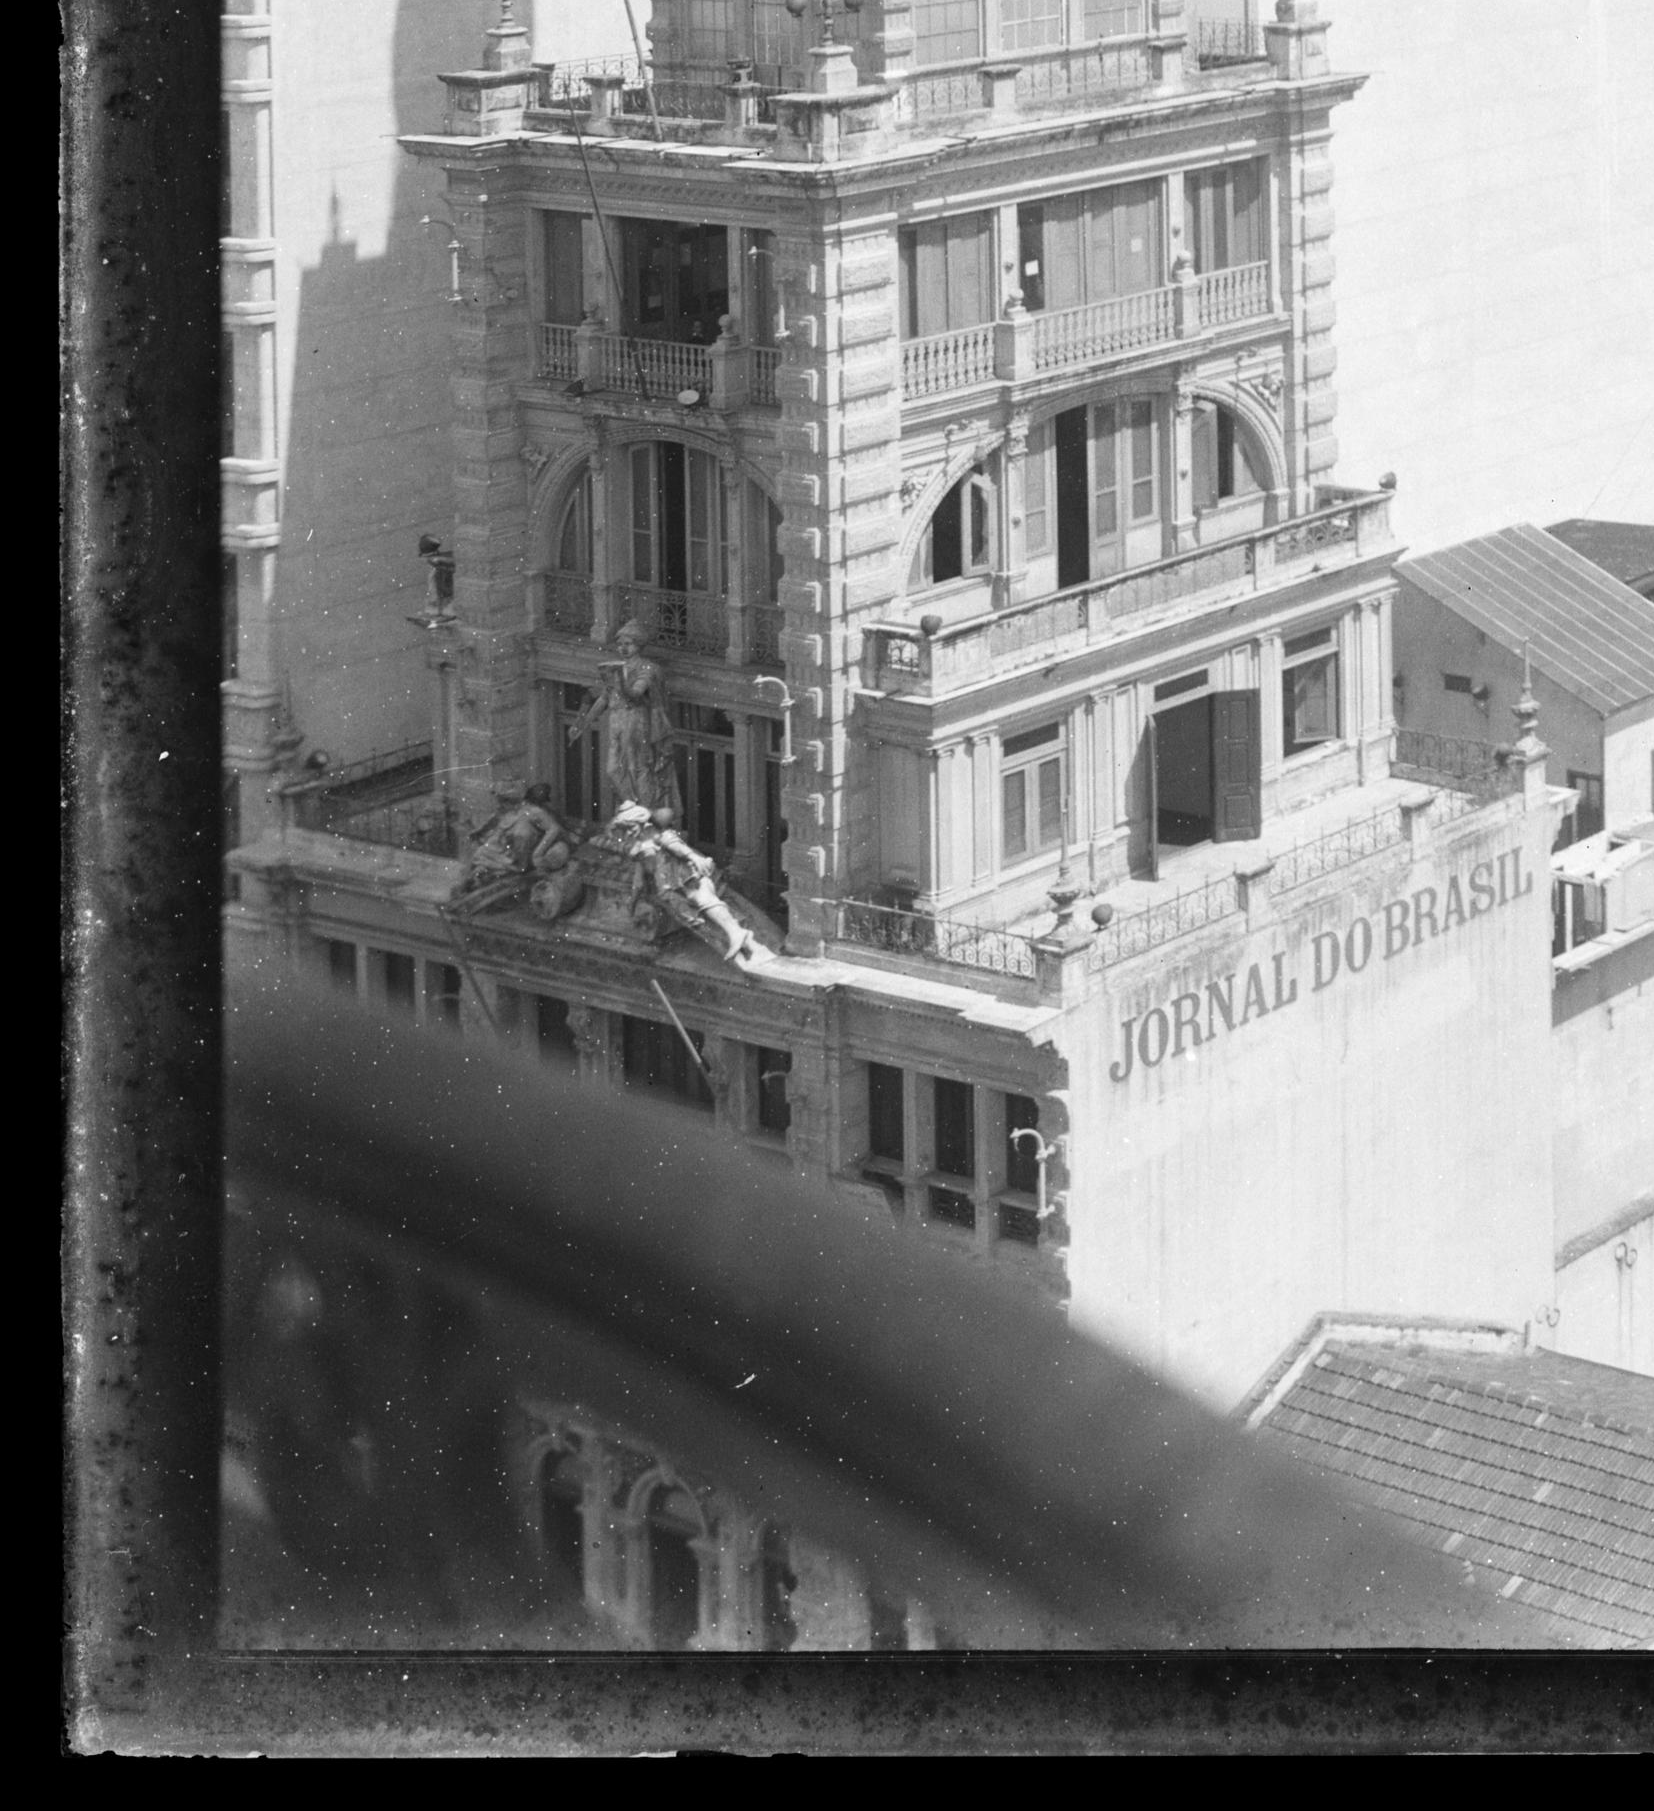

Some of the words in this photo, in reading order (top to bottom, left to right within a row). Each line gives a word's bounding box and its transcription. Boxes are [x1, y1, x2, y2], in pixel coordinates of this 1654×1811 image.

[1109, 951, 1297, 1083] JORNAL
[1311, 916, 1373, 992] DO
[1383, 846, 1532, 961] BRASIL
